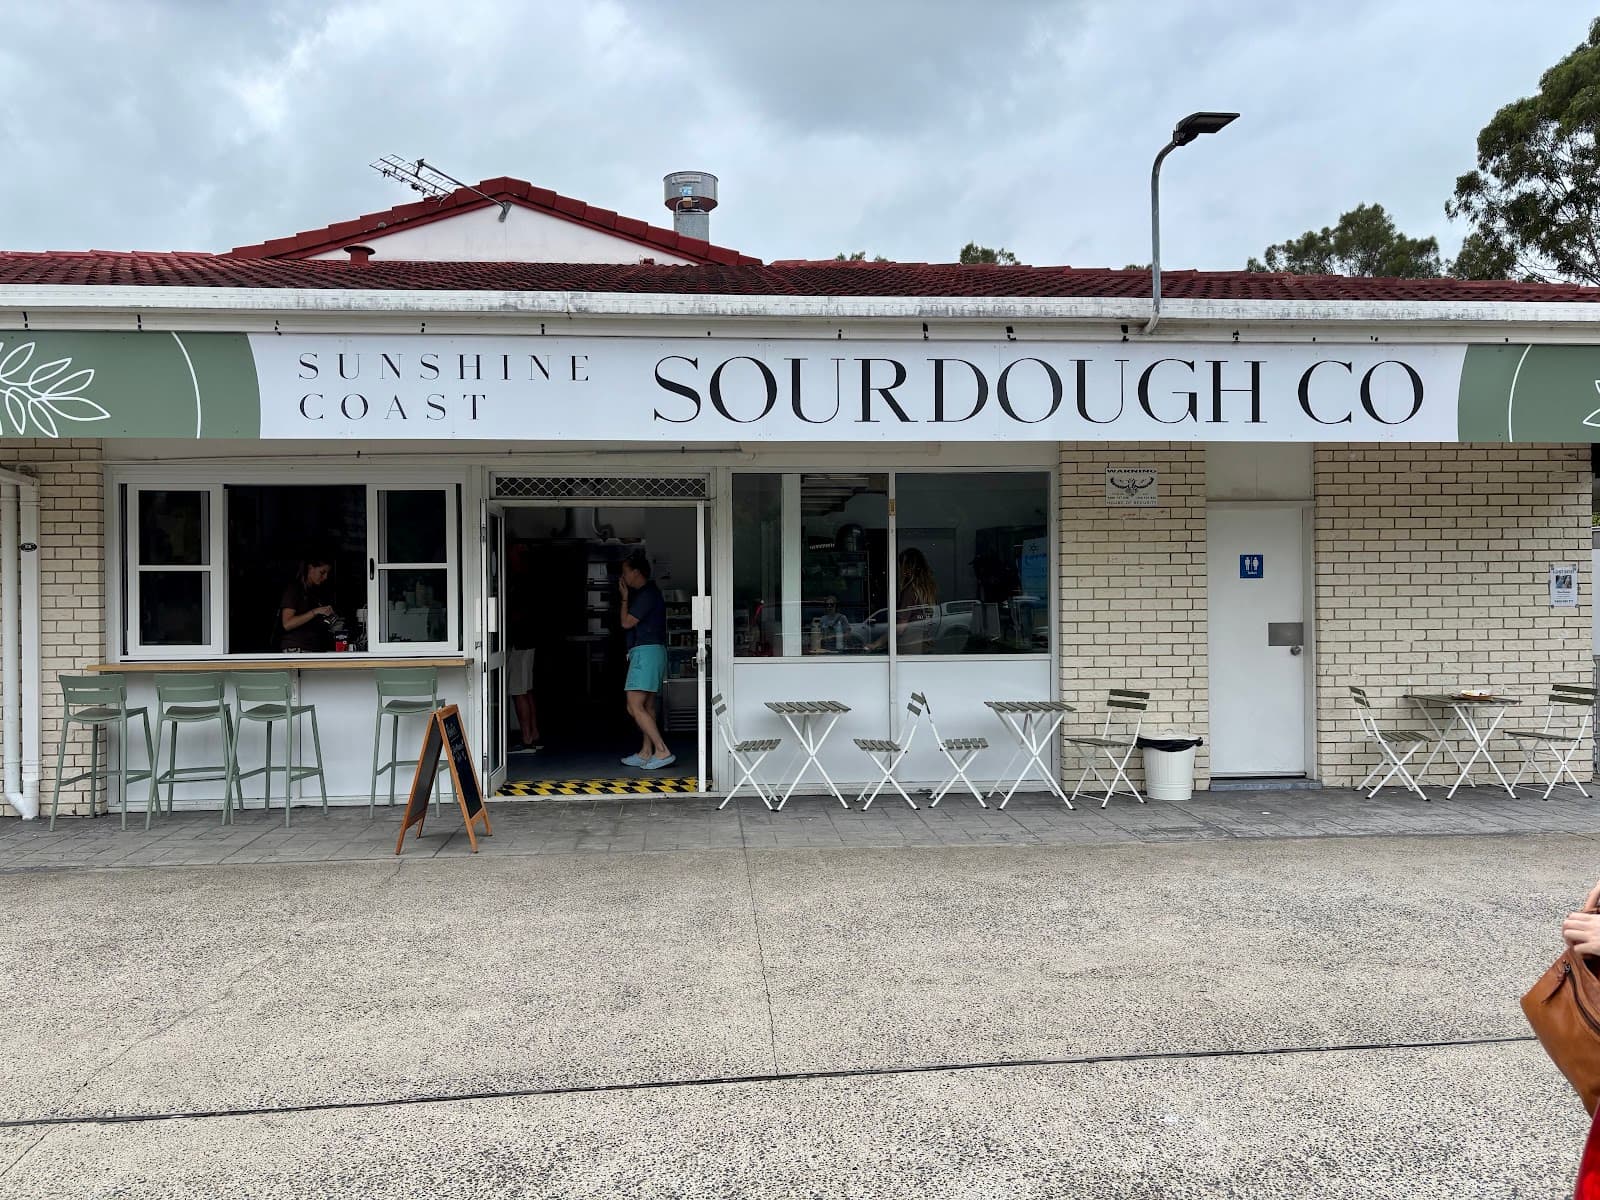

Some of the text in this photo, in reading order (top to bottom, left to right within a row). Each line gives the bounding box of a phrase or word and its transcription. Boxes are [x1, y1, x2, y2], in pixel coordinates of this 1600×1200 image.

[298, 353, 589, 381] SUNSHINE
[653, 355, 1425, 425] SOURDOUGH CO
[299, 393, 486, 420] COAST
